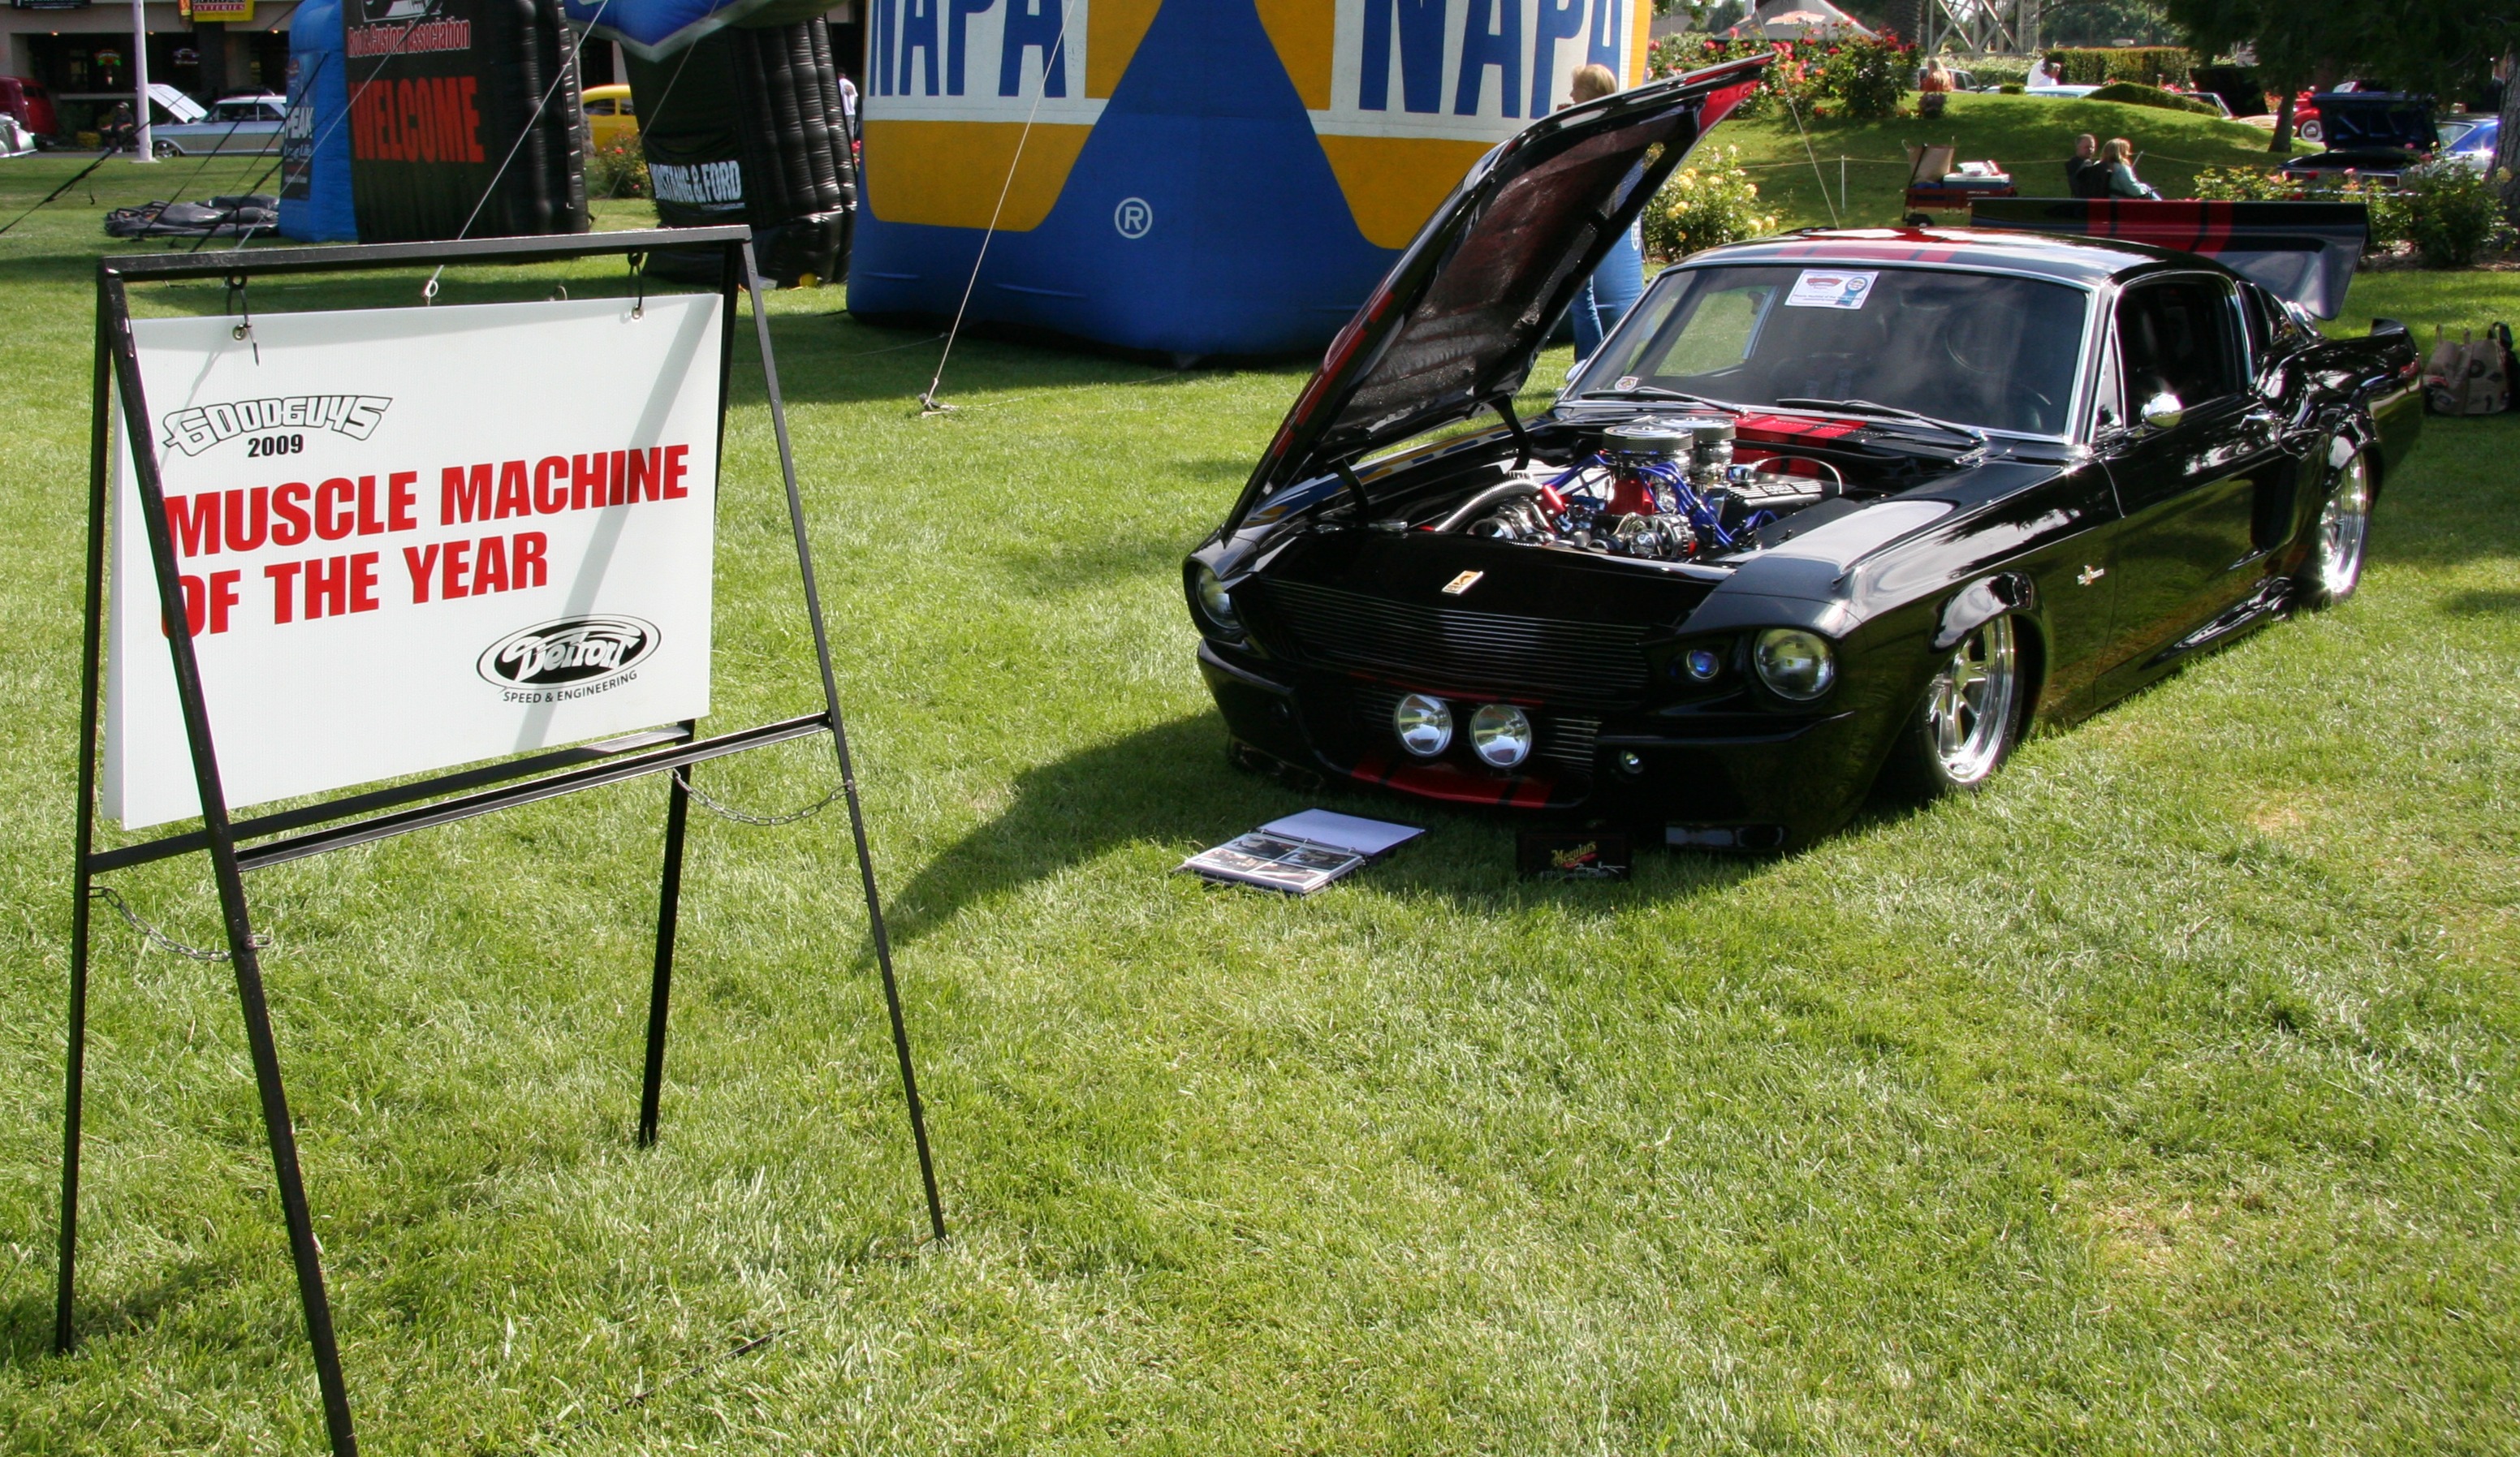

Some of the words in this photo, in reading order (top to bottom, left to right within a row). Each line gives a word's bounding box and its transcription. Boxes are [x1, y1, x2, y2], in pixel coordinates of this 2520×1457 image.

[370, 23, 406, 54] Custom
[407, 15, 471, 54] Association
[285, 106, 314, 139] PEAK
[347, 75, 485, 163] WELCOME
[701, 160, 742, 202] FORD
[162, 395, 393, 457] GOODGUYS
[248, 434, 304, 458] 2009
[162, 471, 417, 563] MUSCLE
[441, 444, 689, 525] MACHINE
[162, 570, 240, 640] OF
[265, 551, 380, 624] THE
[403, 532, 547, 604] YEAR
[503, 691, 542, 704] SPEED
[544, 692, 554, 702] &
[557, 669, 638, 702] ENGINEERING
